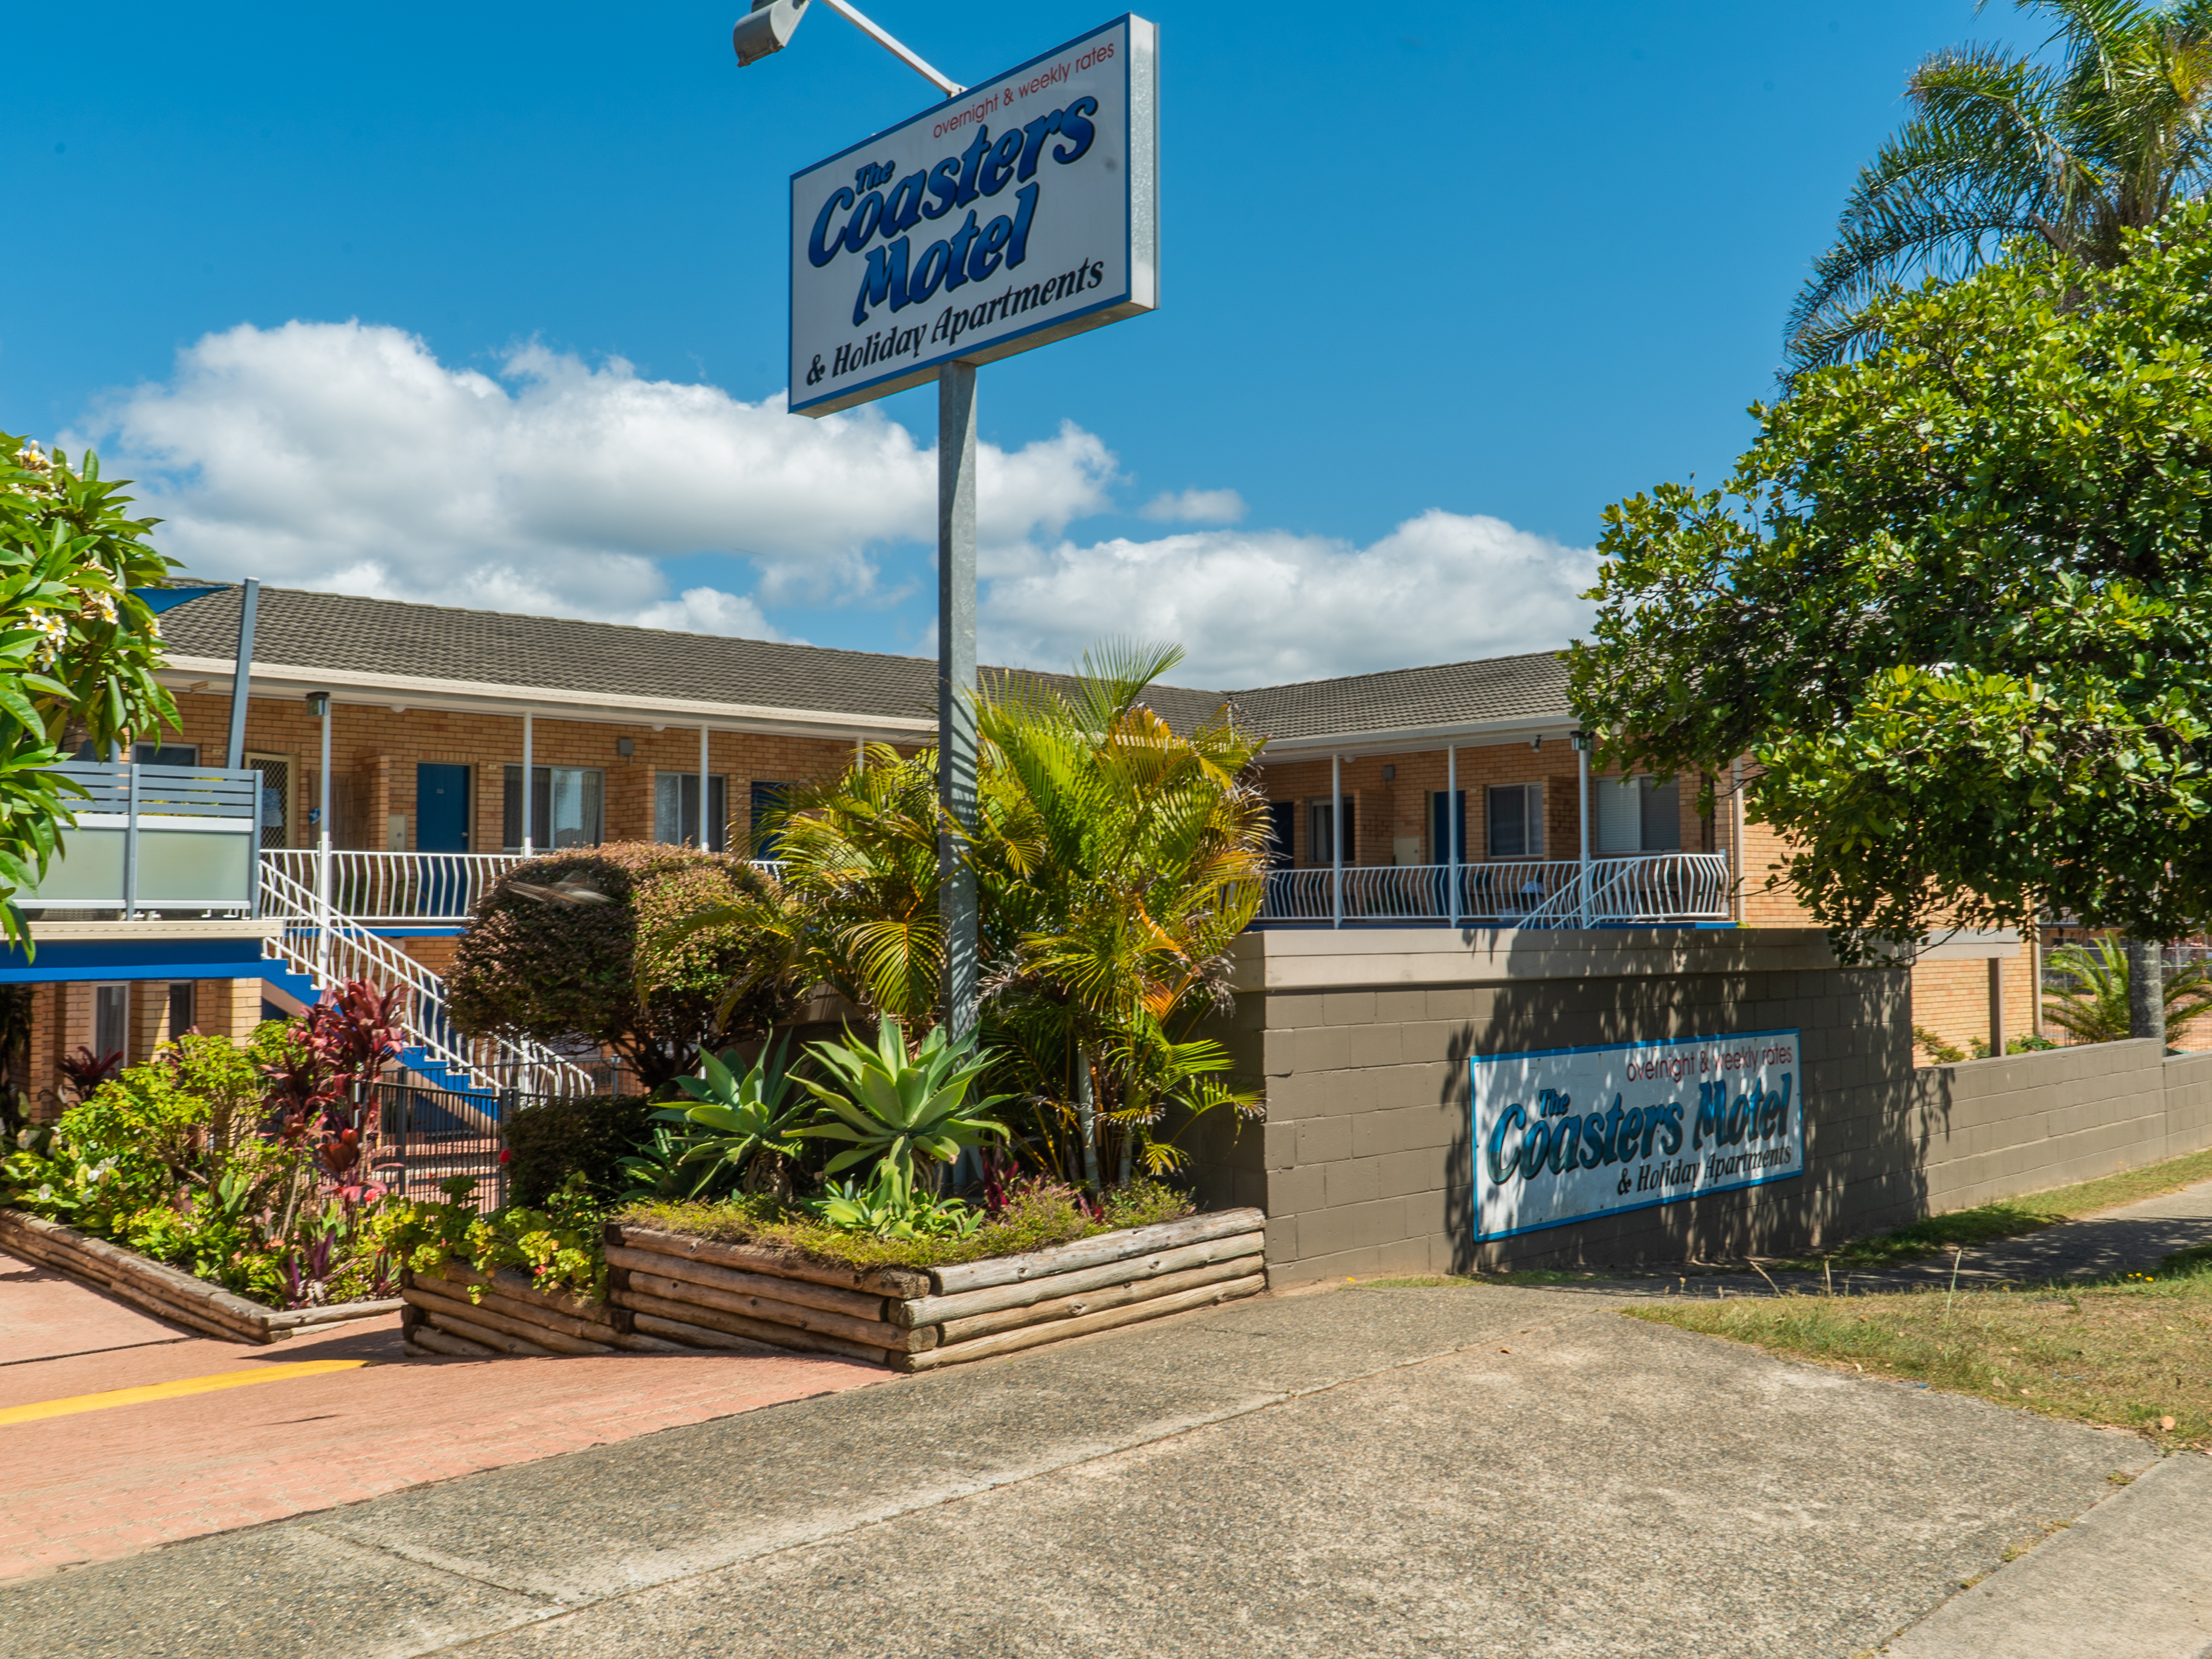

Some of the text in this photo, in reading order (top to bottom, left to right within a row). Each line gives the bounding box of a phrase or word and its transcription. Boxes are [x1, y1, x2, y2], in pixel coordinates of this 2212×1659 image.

[933, 43, 1115, 138] overnight & weekly rates
[808, 95, 1099, 268] Coasters
[854, 160, 896, 195] The
[852, 181, 1040, 327] Motel
[806, 257, 1105, 386] & Holiday Apartments
[1538, 1088, 1570, 1118] The
[1627, 1043, 1793, 1083] overnight & weekly rates
[1487, 1073, 1792, 1185] Coasters Motel
[1617, 1142, 1792, 1196] & Holiday Apartments
